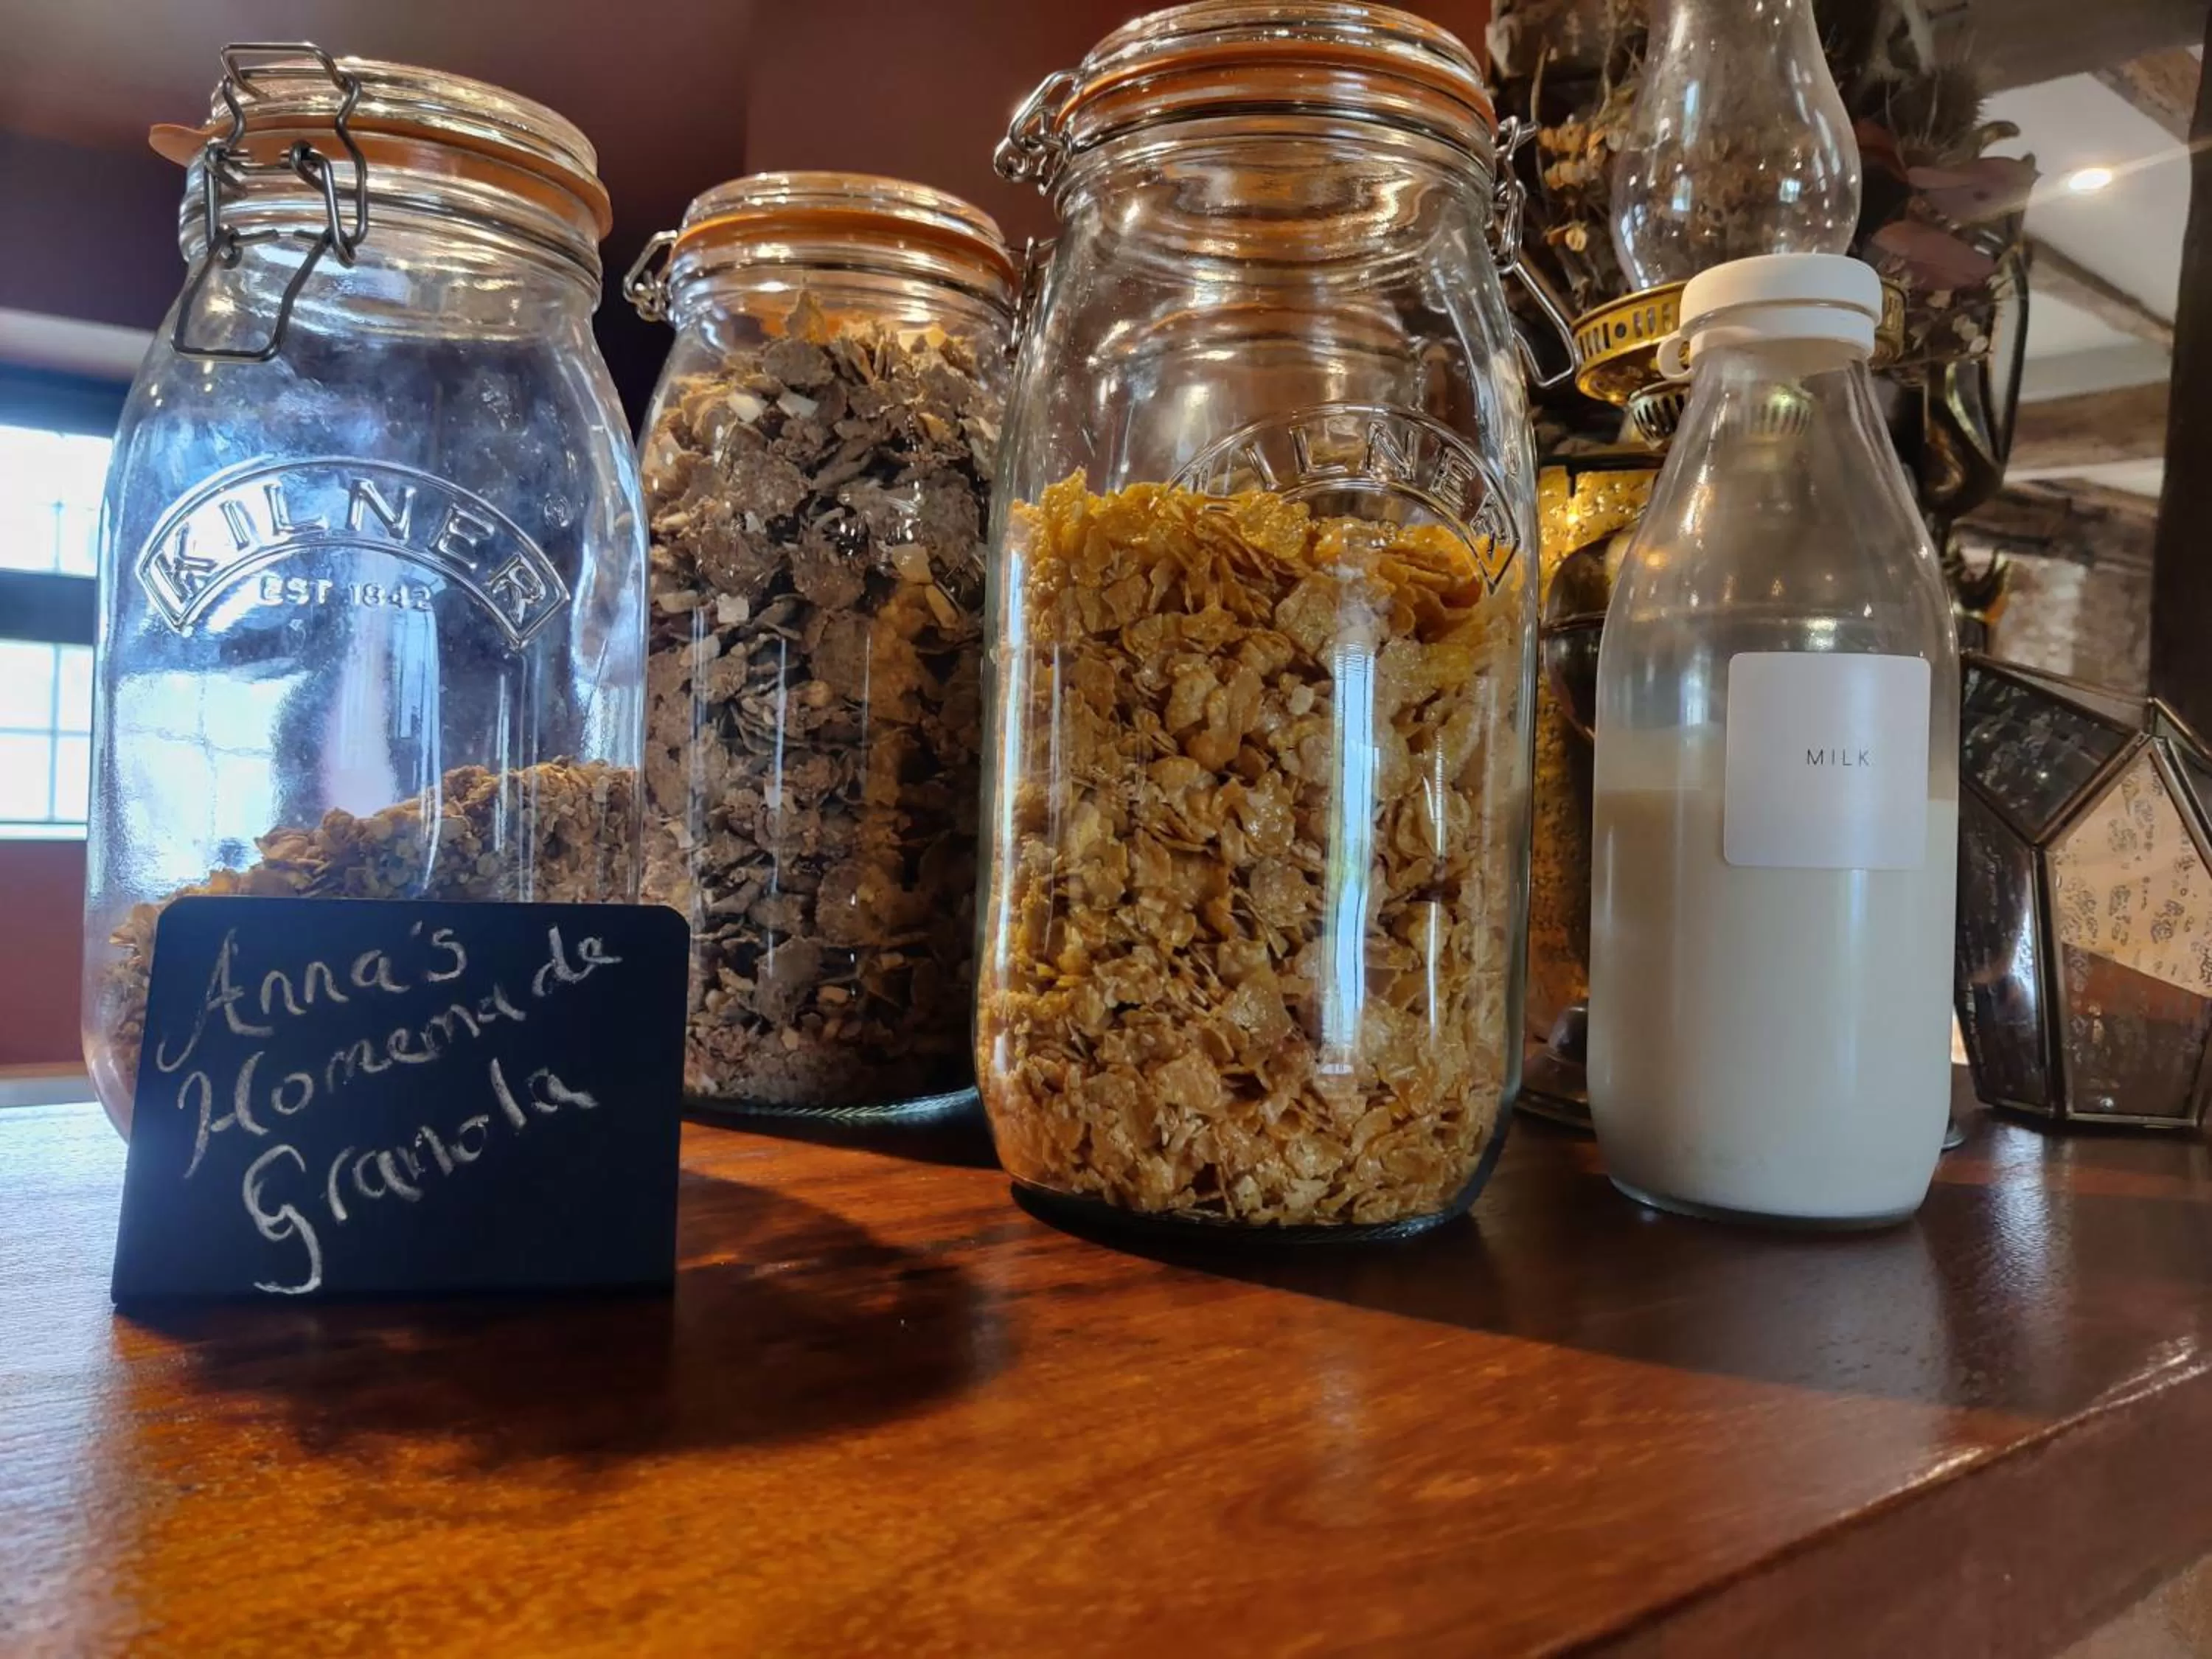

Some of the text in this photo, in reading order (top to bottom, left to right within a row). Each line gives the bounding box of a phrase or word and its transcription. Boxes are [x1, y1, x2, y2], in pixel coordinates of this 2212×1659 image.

[150, 478, 546, 623] KILNER
[260, 574, 333, 605] EST
[1806, 748, 1869, 767] MILK
[157, 920, 467, 1072] Anna's
[177, 925, 622, 1178] Homemade
[242, 1058, 598, 1294] Granola
